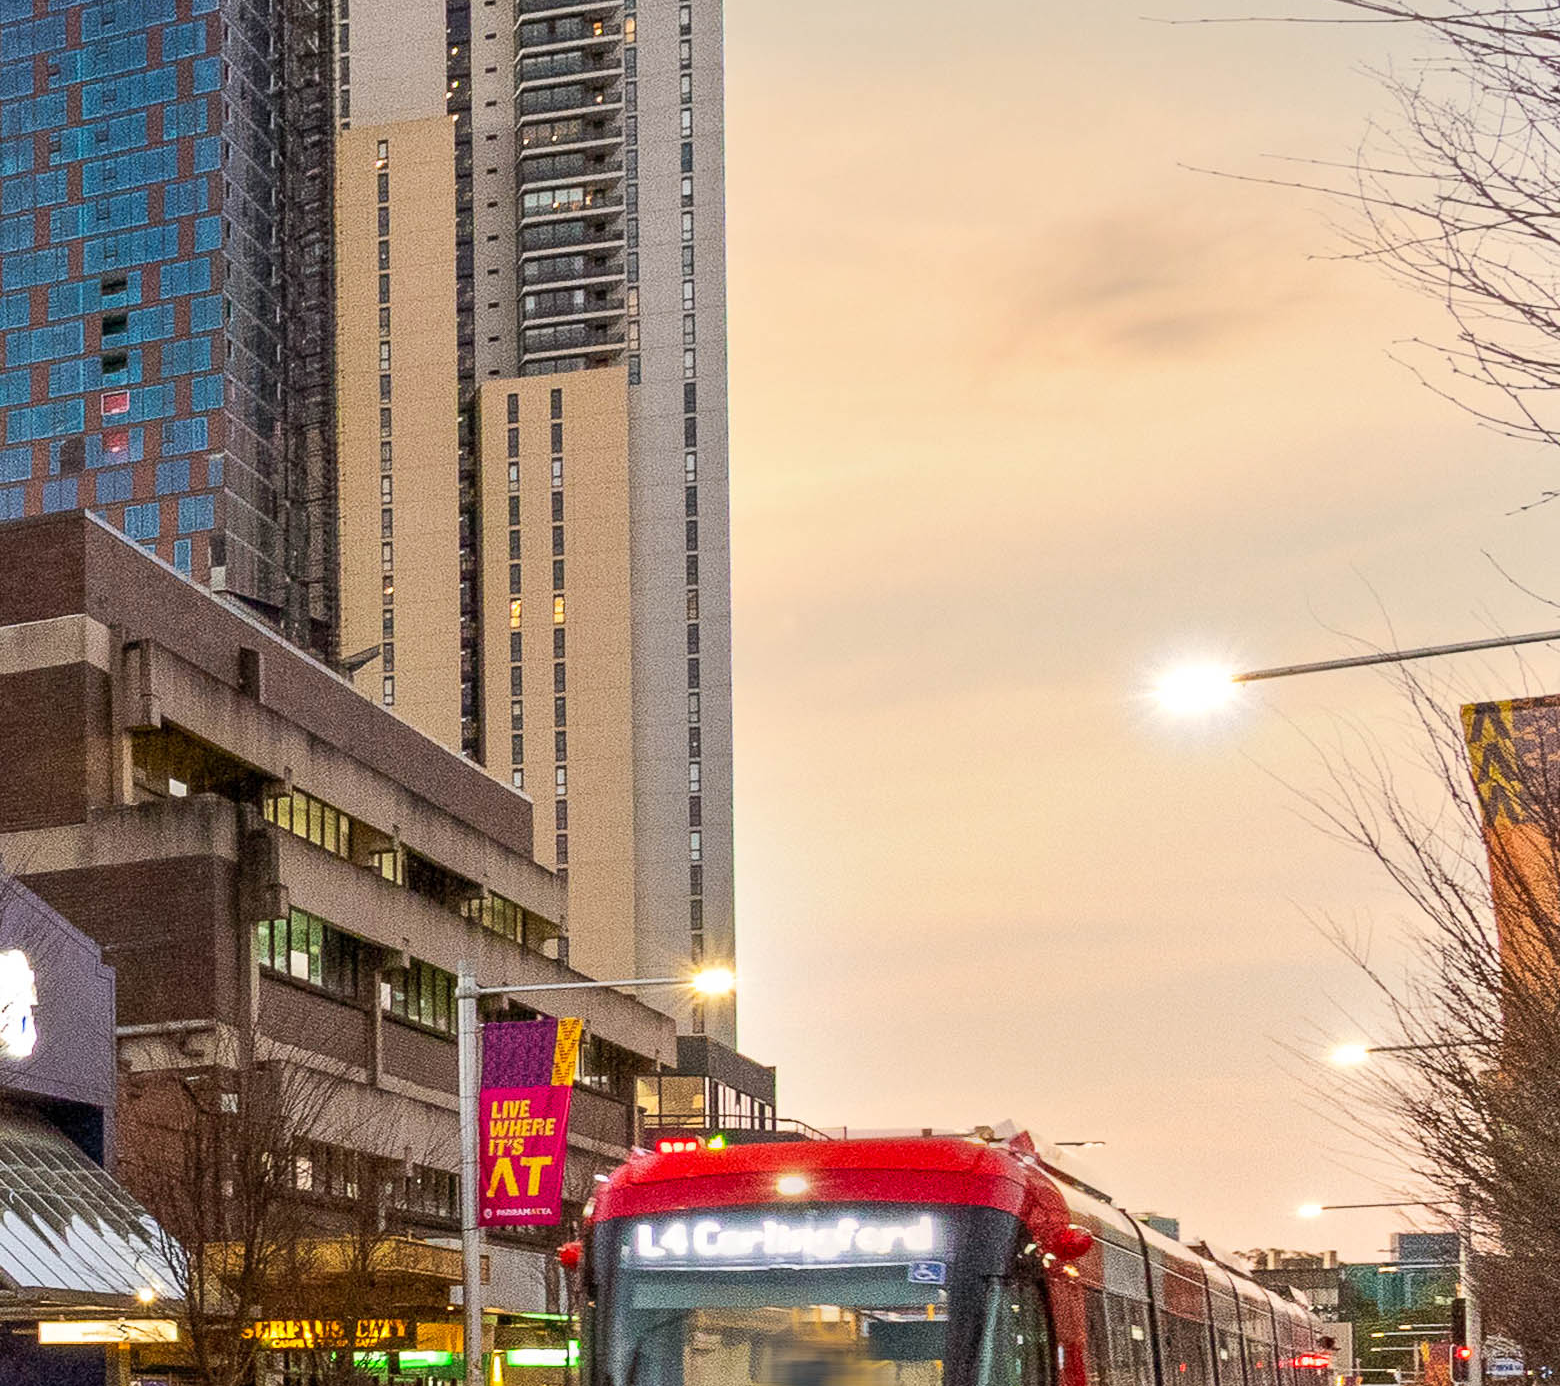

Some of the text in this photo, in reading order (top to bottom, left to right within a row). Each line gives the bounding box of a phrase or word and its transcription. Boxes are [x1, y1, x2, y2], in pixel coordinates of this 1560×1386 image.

[491, 1100, 531, 1118] LIVE
[489, 1118, 556, 1137] WHERE
[488, 1138, 525, 1156] IT'S
[637, 1216, 936, 1259] L4 Carlingford
